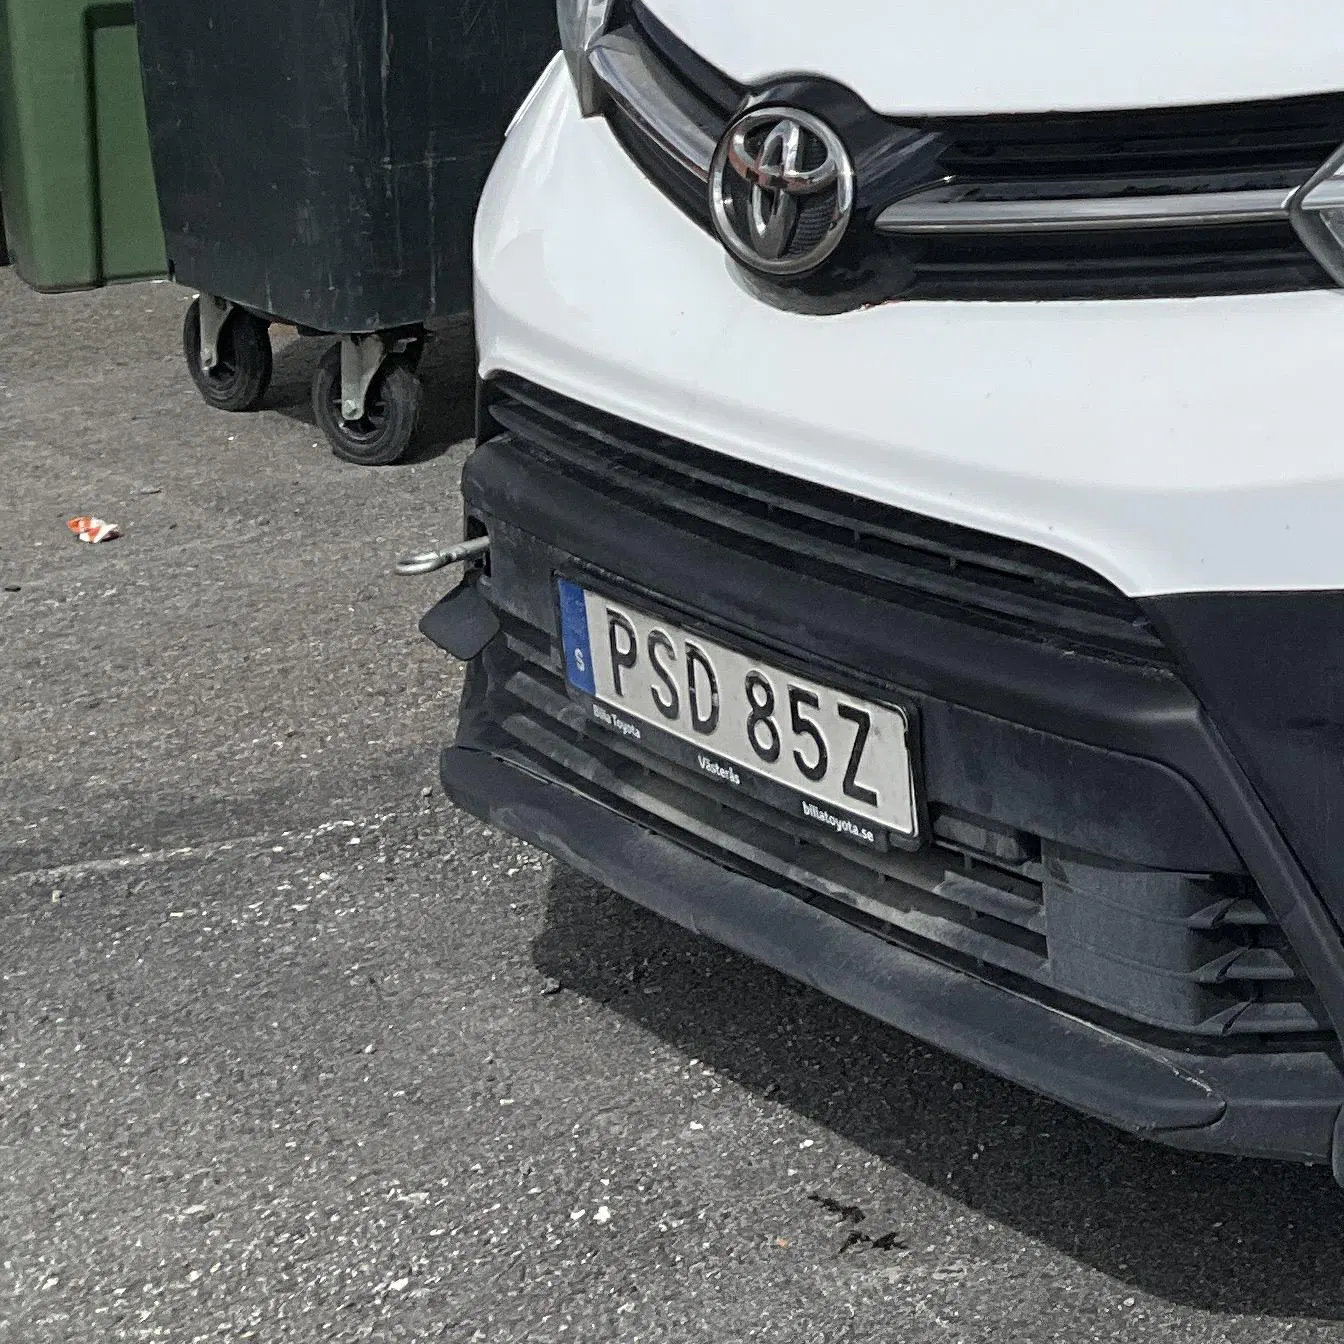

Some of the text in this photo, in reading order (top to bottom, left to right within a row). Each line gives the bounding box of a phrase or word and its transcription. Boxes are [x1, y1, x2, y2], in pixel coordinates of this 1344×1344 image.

[574, 648, 585, 672] S
[606, 607, 878, 807] PSD 85Z
[697, 754, 741, 785] Västerås
